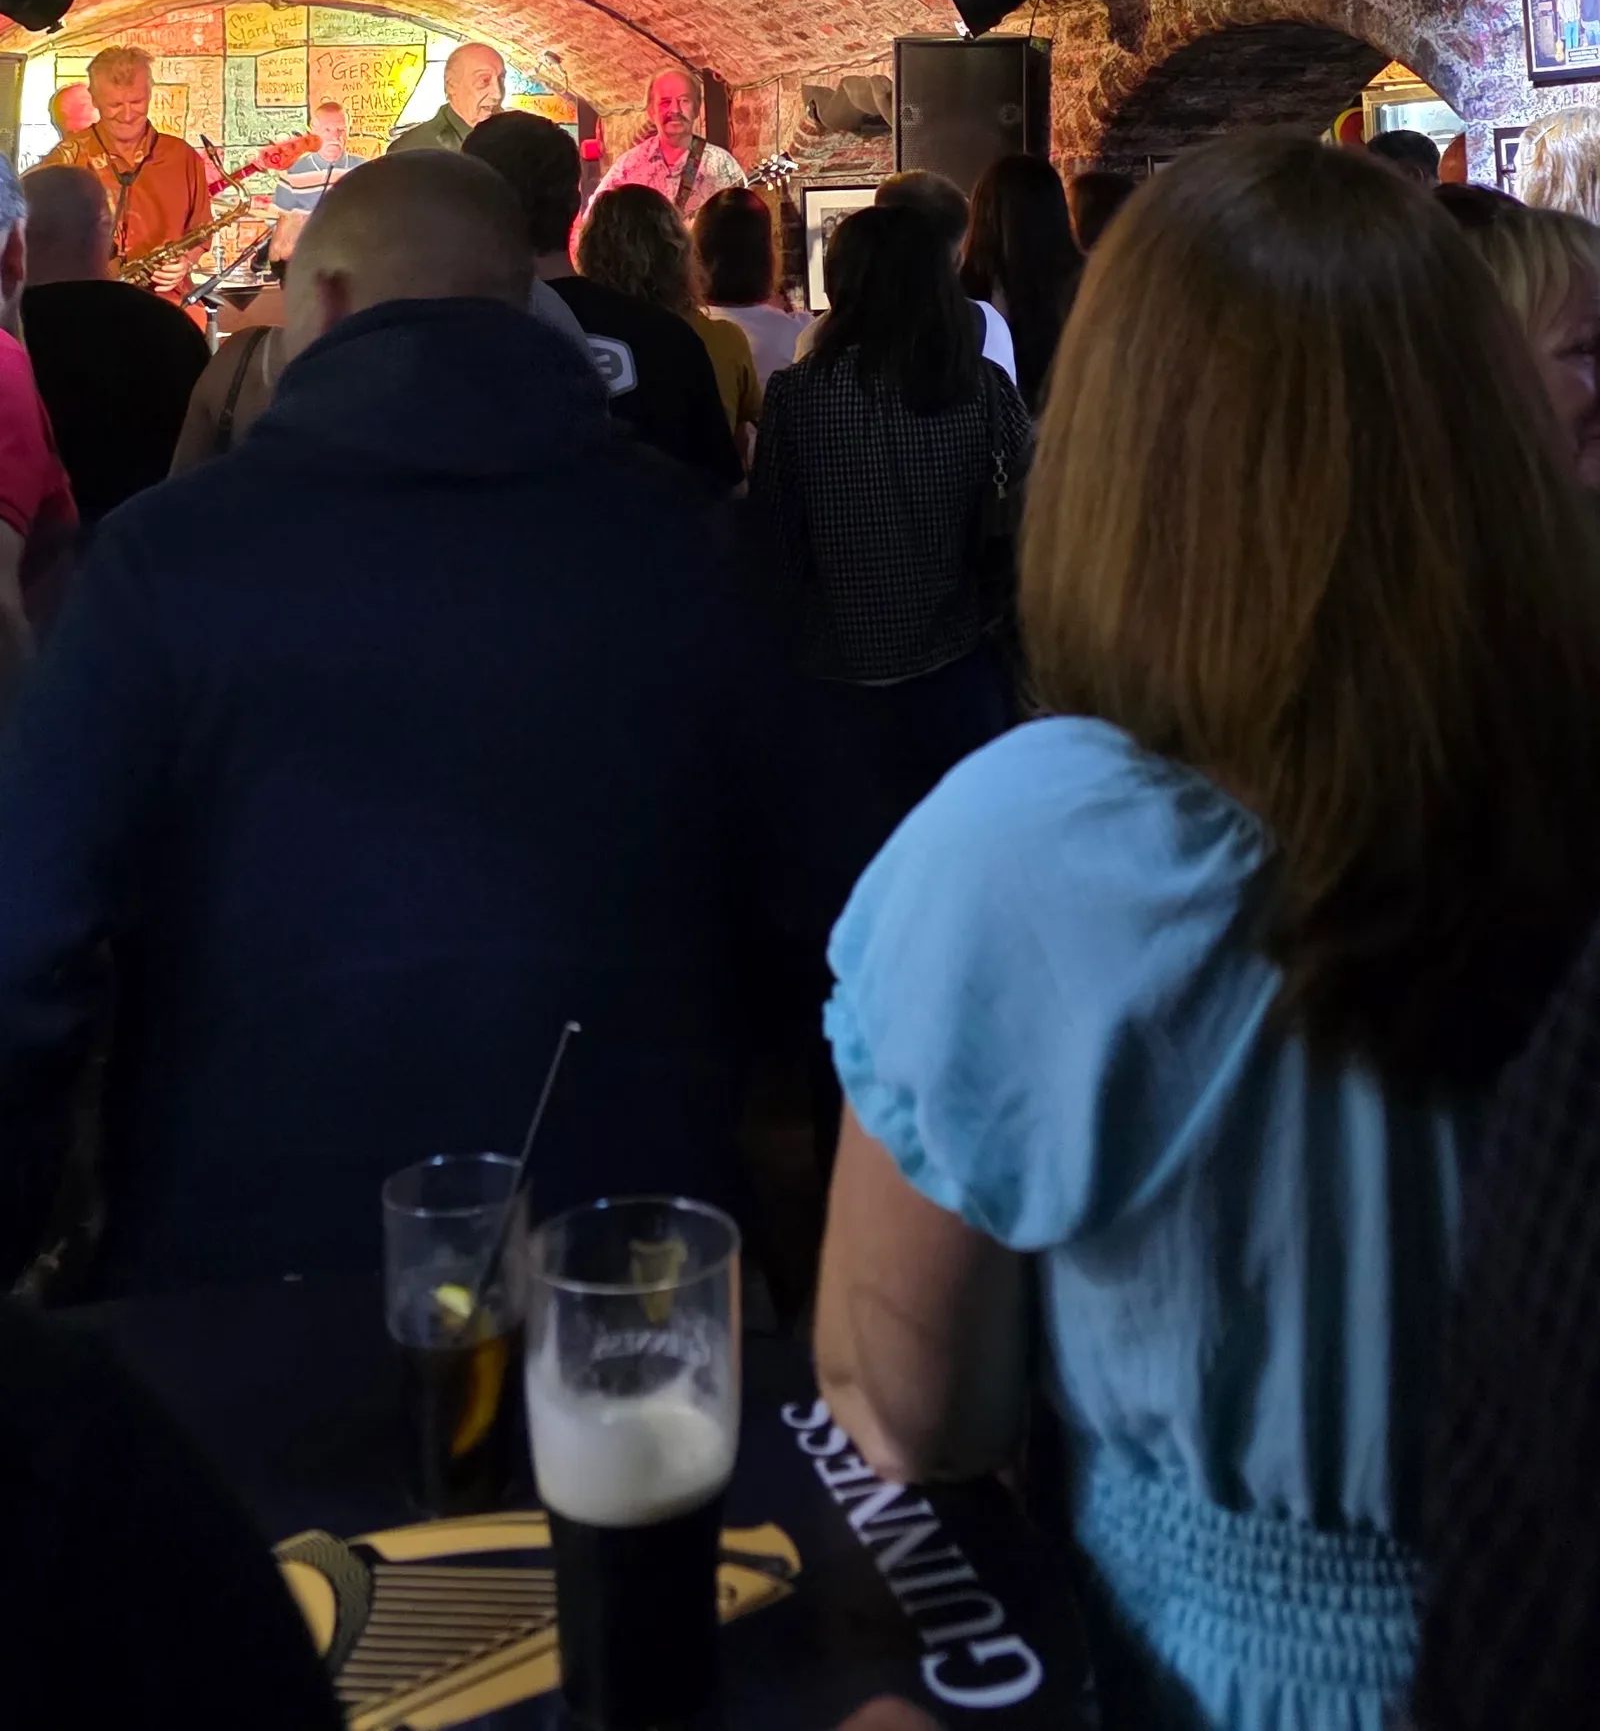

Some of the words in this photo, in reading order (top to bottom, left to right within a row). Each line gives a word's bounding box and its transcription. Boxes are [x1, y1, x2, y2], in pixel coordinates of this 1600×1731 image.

[228, 13, 256, 28] The
[229, 14, 304, 43] Yardbirds
[332, 60, 395, 80] GERRY
[342, 82, 363, 91] AND
[368, 80, 396, 90] THE
[781, 1400, 1043, 1709] GUINNESS
